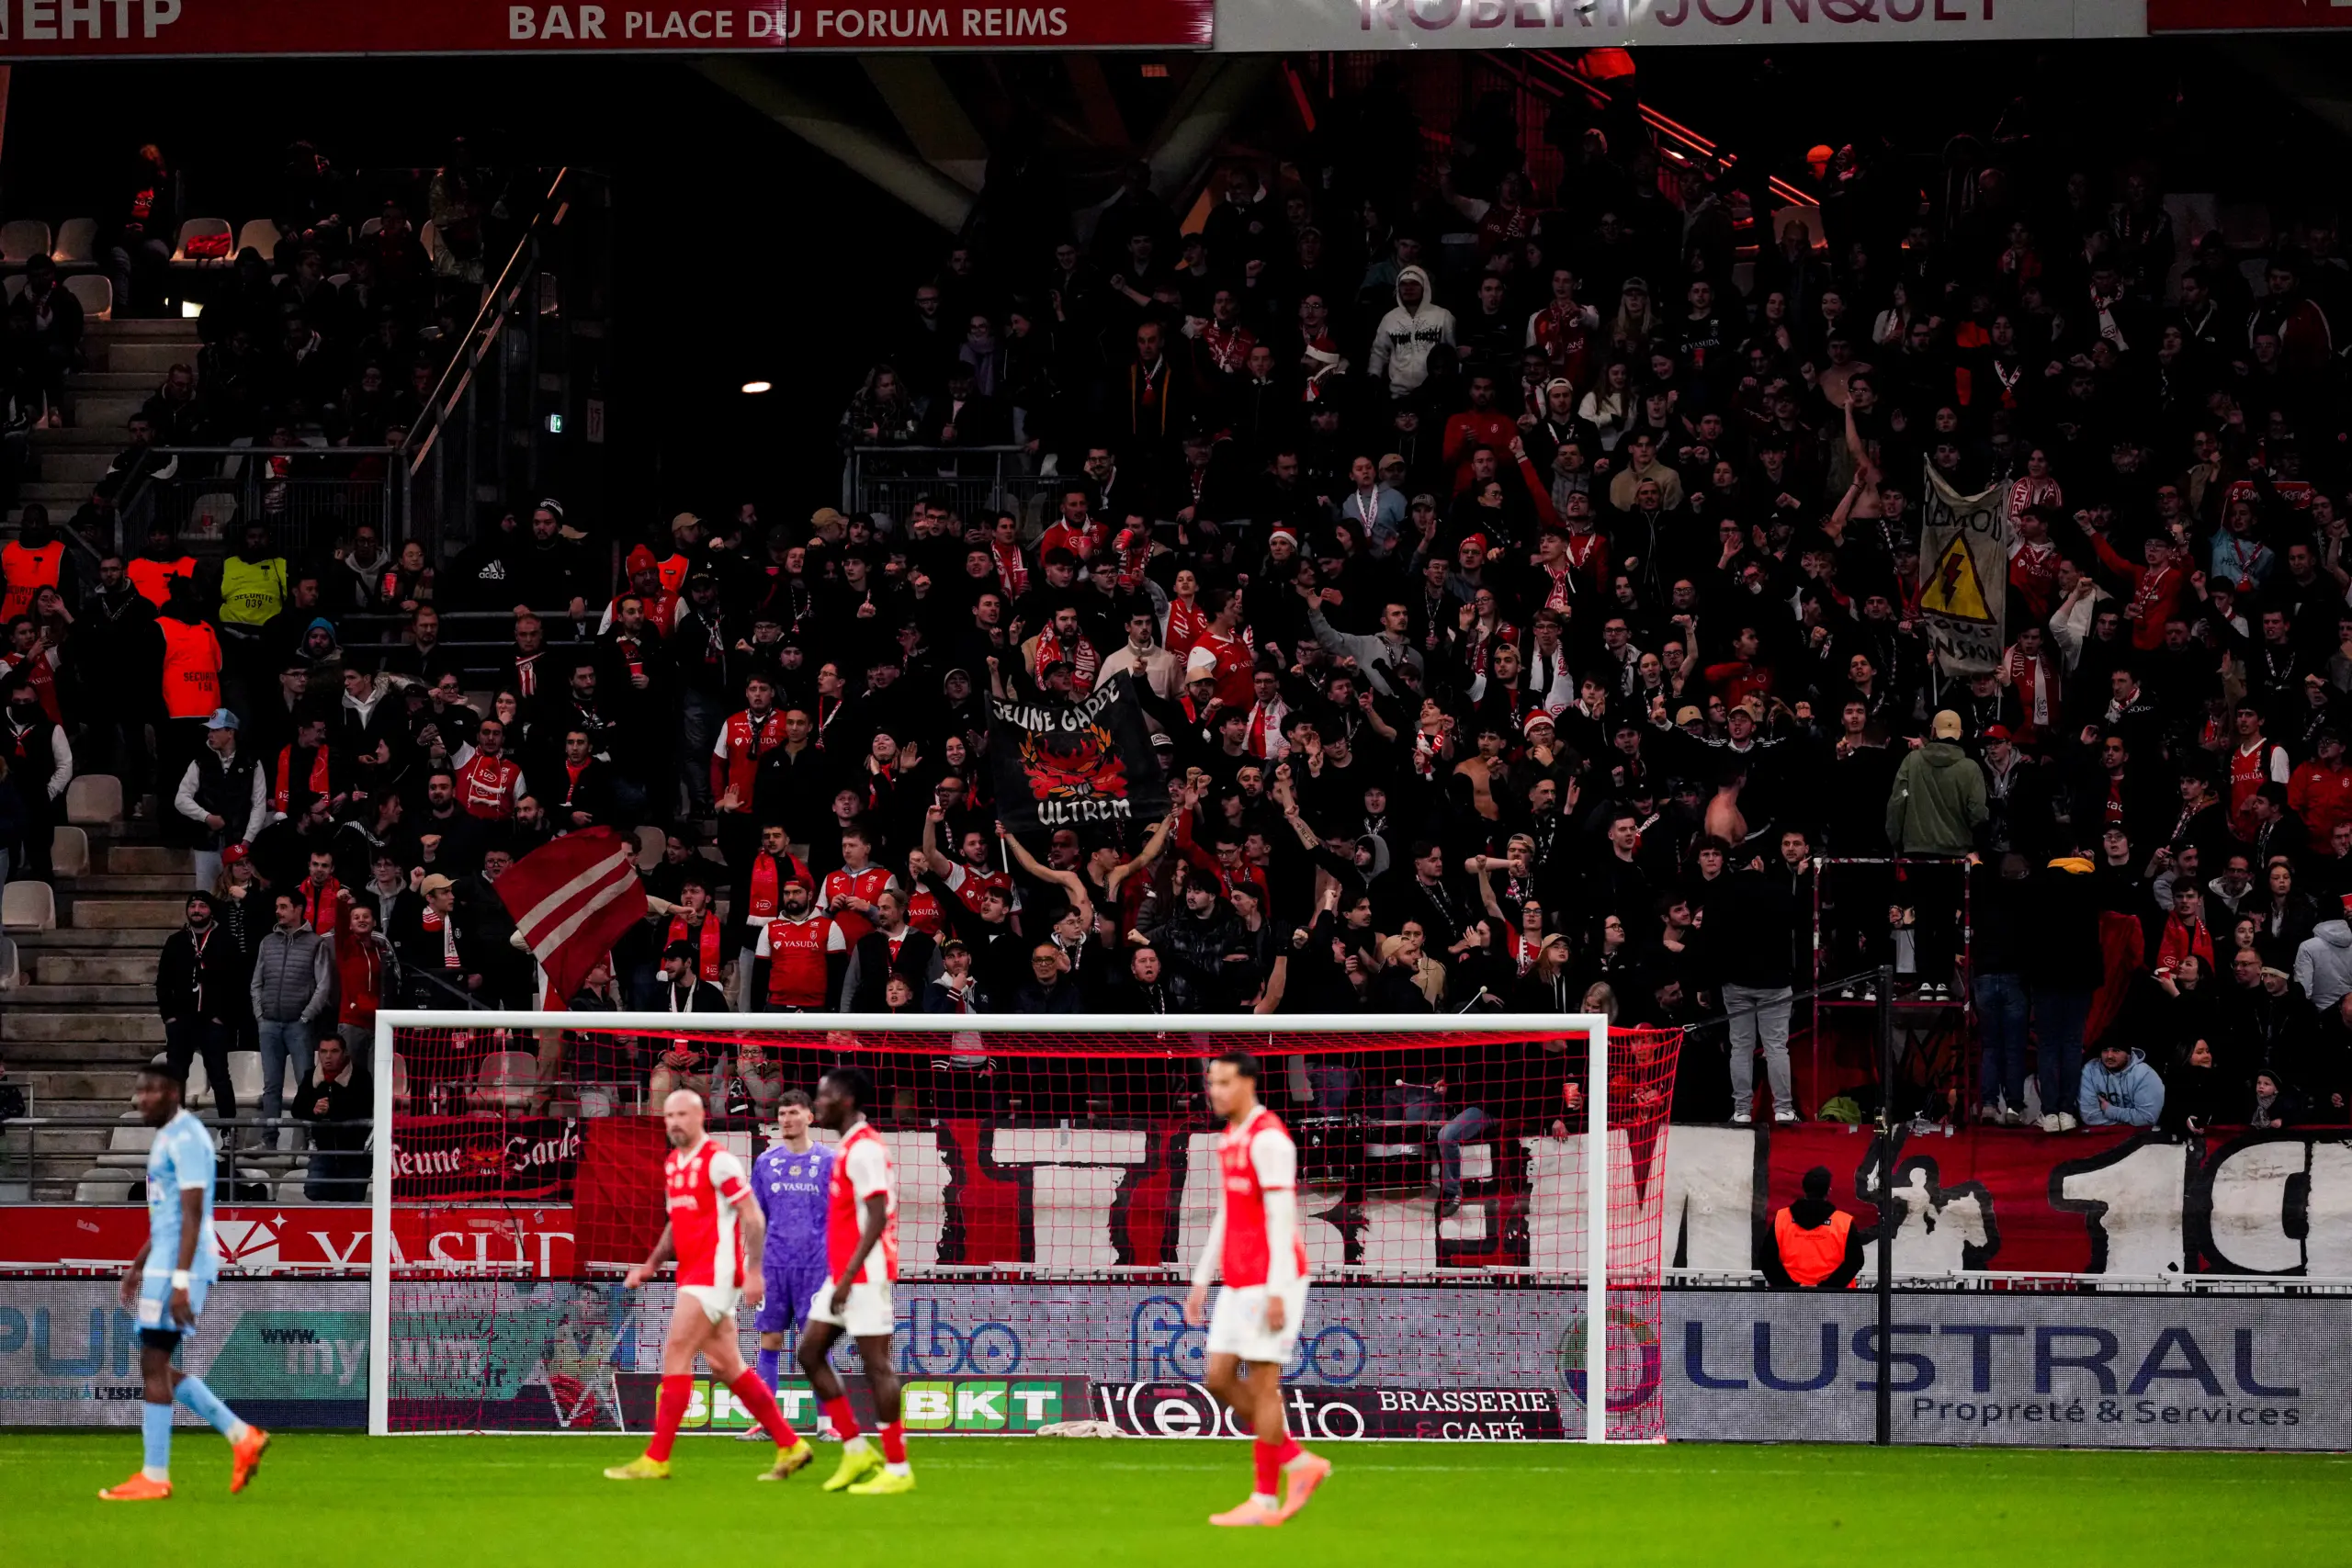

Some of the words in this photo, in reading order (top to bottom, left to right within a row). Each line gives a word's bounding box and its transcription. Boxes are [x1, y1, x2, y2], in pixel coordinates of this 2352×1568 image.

[22, 0, 182, 40] EHTP
[508, 5, 607, 39] BAR
[626, 10, 733, 39] PLACE
[748, 9, 801, 38] DU
[817, 9, 949, 38] FORUM
[963, 7, 1068, 37] REIMS
[245, 599, 263, 609] 039
[993, 700, 1056, 732] JEUNE
[1037, 798, 1132, 826] ULTREM
[908, 908, 939, 917] YASUDA
[784, 940, 820, 949] YASUDA
[783, 1182, 820, 1193] YASUDA
[1685, 1321, 2301, 1397] LUSTRAL
[903, 1390, 1057, 1421] BKT
[1381, 1390, 1553, 1413] BRASSERIE
[1913, 1397, 2085, 1427] Propreté
[2097, 1400, 2124, 1423] &
[2134, 1400, 2301, 1426] Services
[1442, 1415, 1526, 1440] CAFÉ
